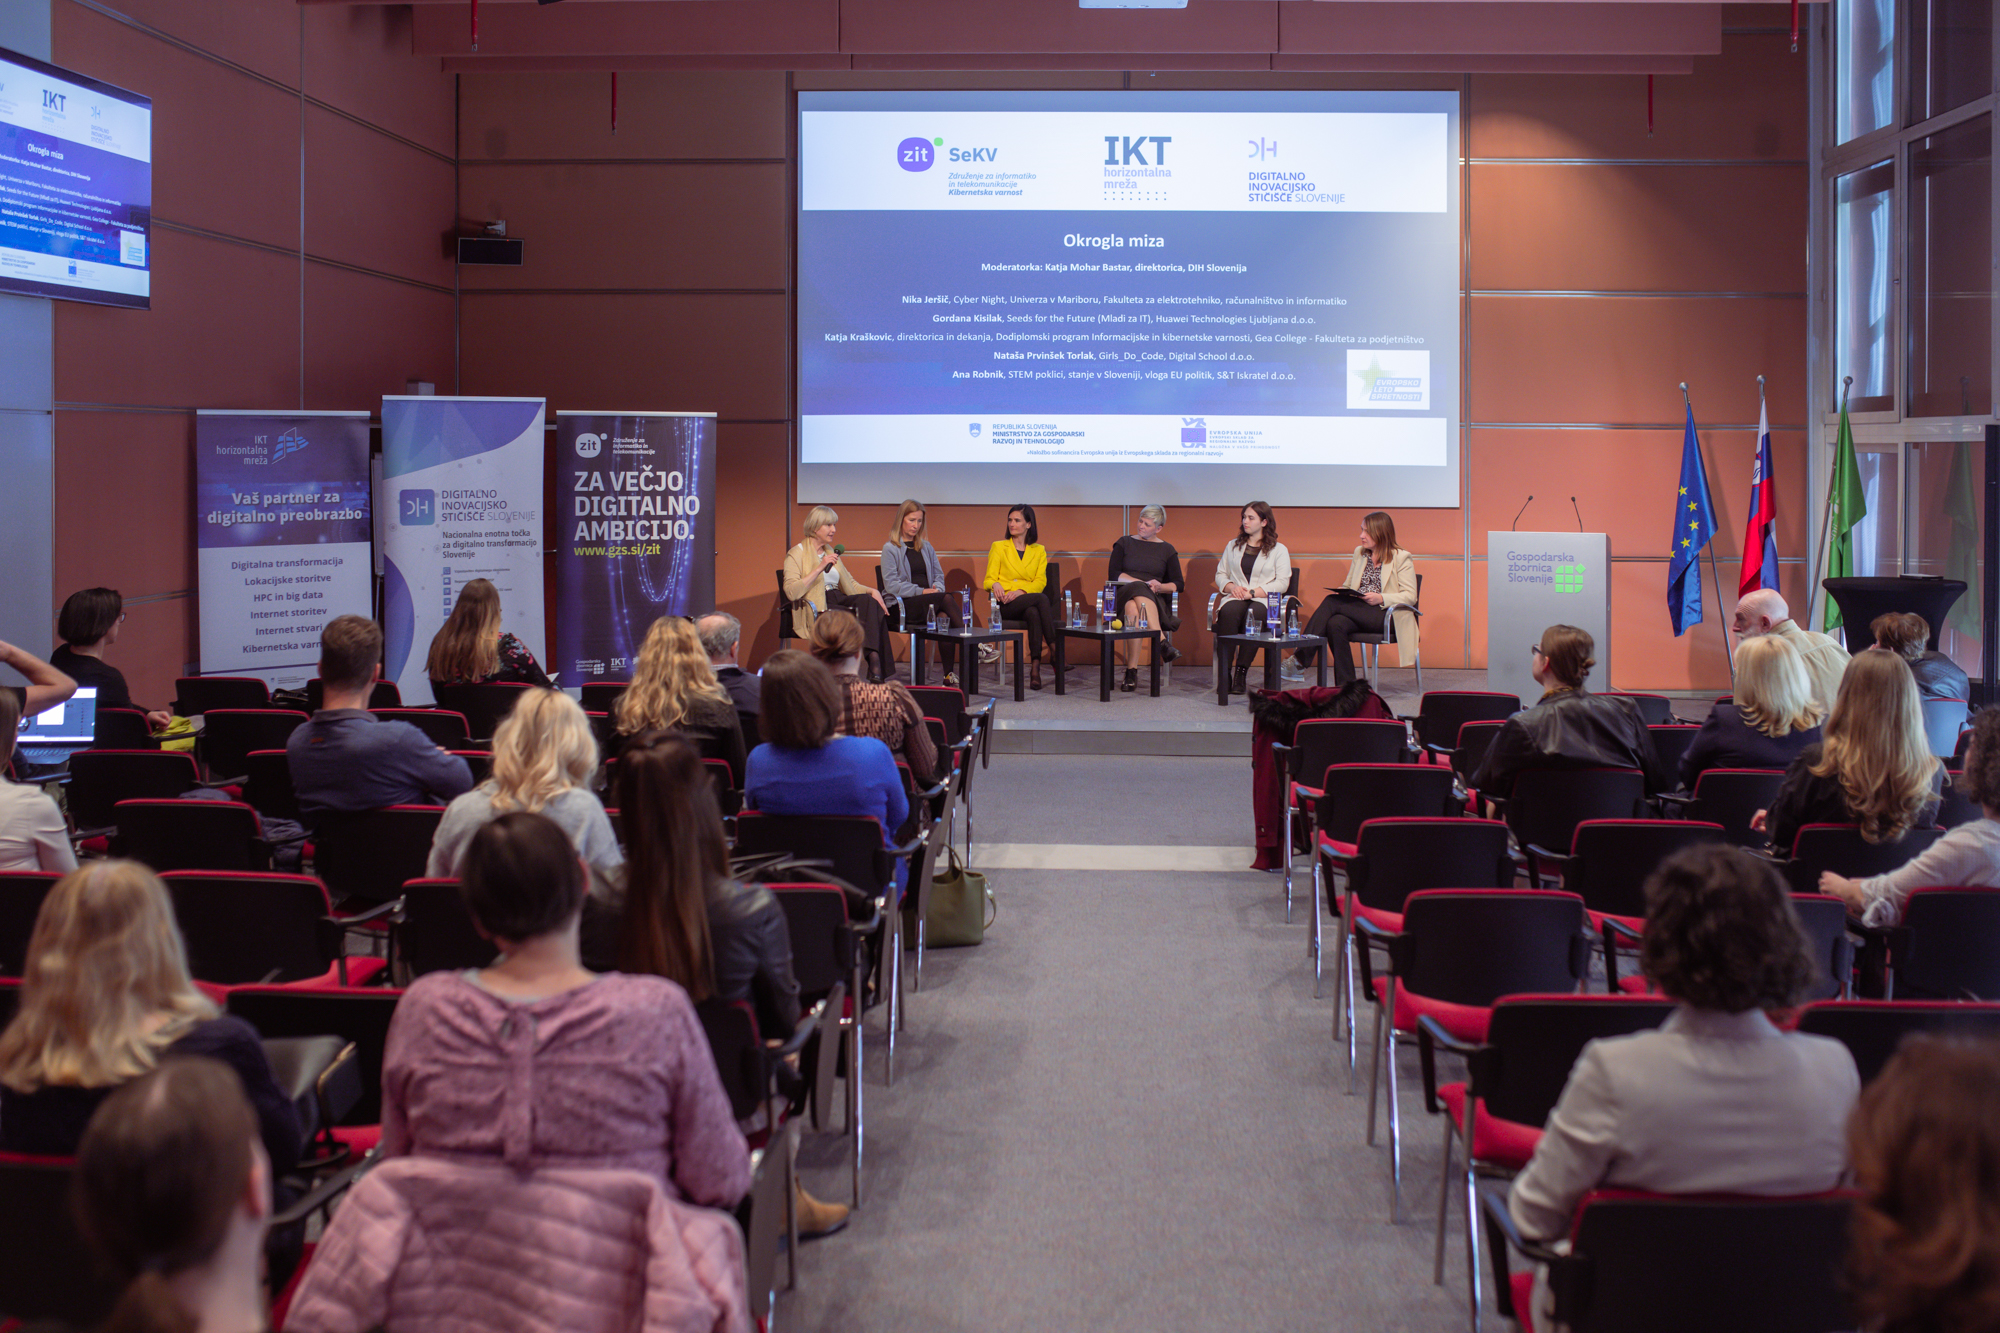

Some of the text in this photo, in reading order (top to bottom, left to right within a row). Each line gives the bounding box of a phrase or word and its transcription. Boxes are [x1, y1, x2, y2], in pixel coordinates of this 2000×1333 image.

[43, 89, 67, 112] IKT
[28, 143, 63, 160] Okrogla miza
[904, 146, 928, 162] zit
[949, 148, 998, 162] SeKV
[1104, 136, 1172, 165] IKT
[948, 172, 984, 182] Združenje
[995, 172, 1037, 181] informatiko
[1104, 167, 1172, 177] horizontalna
[1249, 172, 1305, 181] DIGITALNO
[956, 181, 1018, 189] telekomunikacije
[1104, 178, 1137, 189] mreža
[1249, 182, 1315, 192] INOVACIJSKO
[1248, 192, 1345, 204] STIČIŠČE SLOVENIJE
[1064, 234, 1164, 250] Okrogla miza
[981, 263, 1247, 273] Moderatorka: Katja Mohar Bastar, direktorica, DIH Slovenija
[902, 295, 923, 303] Nika
[924, 295, 951, 304] Jeršič,
[953, 295, 979, 305] Cyber
[981, 295, 1008, 305] Night,
[1058, 295, 1101, 304] Mariboru,
[1103, 296, 1143, 304] Fakulteta
[1157, 296, 1223, 304] elektrotehniko,
[1225, 296, 1284, 305] računalništvo
[1296, 297, 1347, 305] informatiko
[932, 314, 972, 322] Gordana
[974, 314, 1005, 323] Kisilak,
[1007, 314, 1033, 322] Seeds
[1034, 314, 1048, 322] for
[1050, 314, 1065, 322] the
[1066, 314, 1096, 322] Future
[1098, 314, 1126, 324] (Mladi
[1140, 314, 1153, 324] IT),
[1156, 315, 1189, 323] Huawei
[1190, 315, 1247, 325] Technologies
[1249, 315, 1289, 325] Ljubljana
[1290, 316, 1316, 324] d.o.o.
[824, 333, 848, 343] Katja
[850, 333, 895, 341] Kraškovic,
[897, 333, 944, 341] direktorica
[956, 333, 993, 342] dekanja,
[996, 333, 1050, 342] Dodiplomski
[1052, 334, 1089, 342] program
[1092, 333, 1150, 342] Informacijske
[1152, 333, 1160, 341] in
[1162, 333, 1213, 341] kibernetske
[1214, 334, 1253, 342] varnosti,
[1254, 334, 1273, 342] Gea
[1274, 334, 1307, 344] College
[1315, 335, 1355, 343] Fakulteta
[1369, 336, 1424, 344] podjetništvo
[994, 351, 1255, 362] Nataša Prvinšek Torlak, Girls_Do_Code, Digital School d.o.o.
[972, 370, 1006, 379] Robnik,
[1008, 370, 1033, 378] STEM
[1035, 370, 1066, 380] poklici,
[1068, 371, 1095, 380] stanje
[1104, 371, 1143, 380] Sloveniji,
[1144, 371, 1168, 381] vloga
[1170, 371, 1183, 379] EU
[1185, 371, 1215, 380] politik,
[1217, 371, 1235, 379] S&T
[1237, 371, 1269, 380] Iskratel
[1270, 372, 1296, 380] d.o.o.
[992, 424, 1057, 432] REPUBLIKA SLOVENIJA
[254, 435, 268, 444] IKT
[216, 445, 268, 455] horizontalna
[580, 440, 597, 451] zit
[244, 456, 268, 465] mreža
[574, 464, 684, 492] ZA VEČJO
[231, 491, 340, 507] Vaš partner za
[442, 490, 497, 499] DIGITALNO
[442, 500, 508, 511] INOVACIJSKO
[574, 495, 700, 516] DIGITALNO
[207, 508, 363, 527] digitalno preobrazbo
[441, 510, 536, 522] STIČIŠČE SLOVENIJE
[511, 529, 531, 537] točka
[574, 519, 695, 541] AMBICIJO.
[452, 540, 485, 550] digitalno
[486, 539, 537, 547] transformacijo
[442, 551, 476, 559] Slovenije
[574, 543, 662, 558] www.gzs.si/zit
[1506, 551, 1575, 563] Gospodarska
[231, 557, 343, 571] Digitalna transformacija
[1508, 562, 1553, 572] zbornica
[245, 575, 331, 586] Lokacijske storitve
[1508, 572, 1553, 585] Slovenije
[254, 591, 323, 602] HPC in big data
[250, 608, 327, 619] Internet storitev
[256, 624, 323, 635] Internet stvari
[242, 642, 298, 653] Kibernetska
